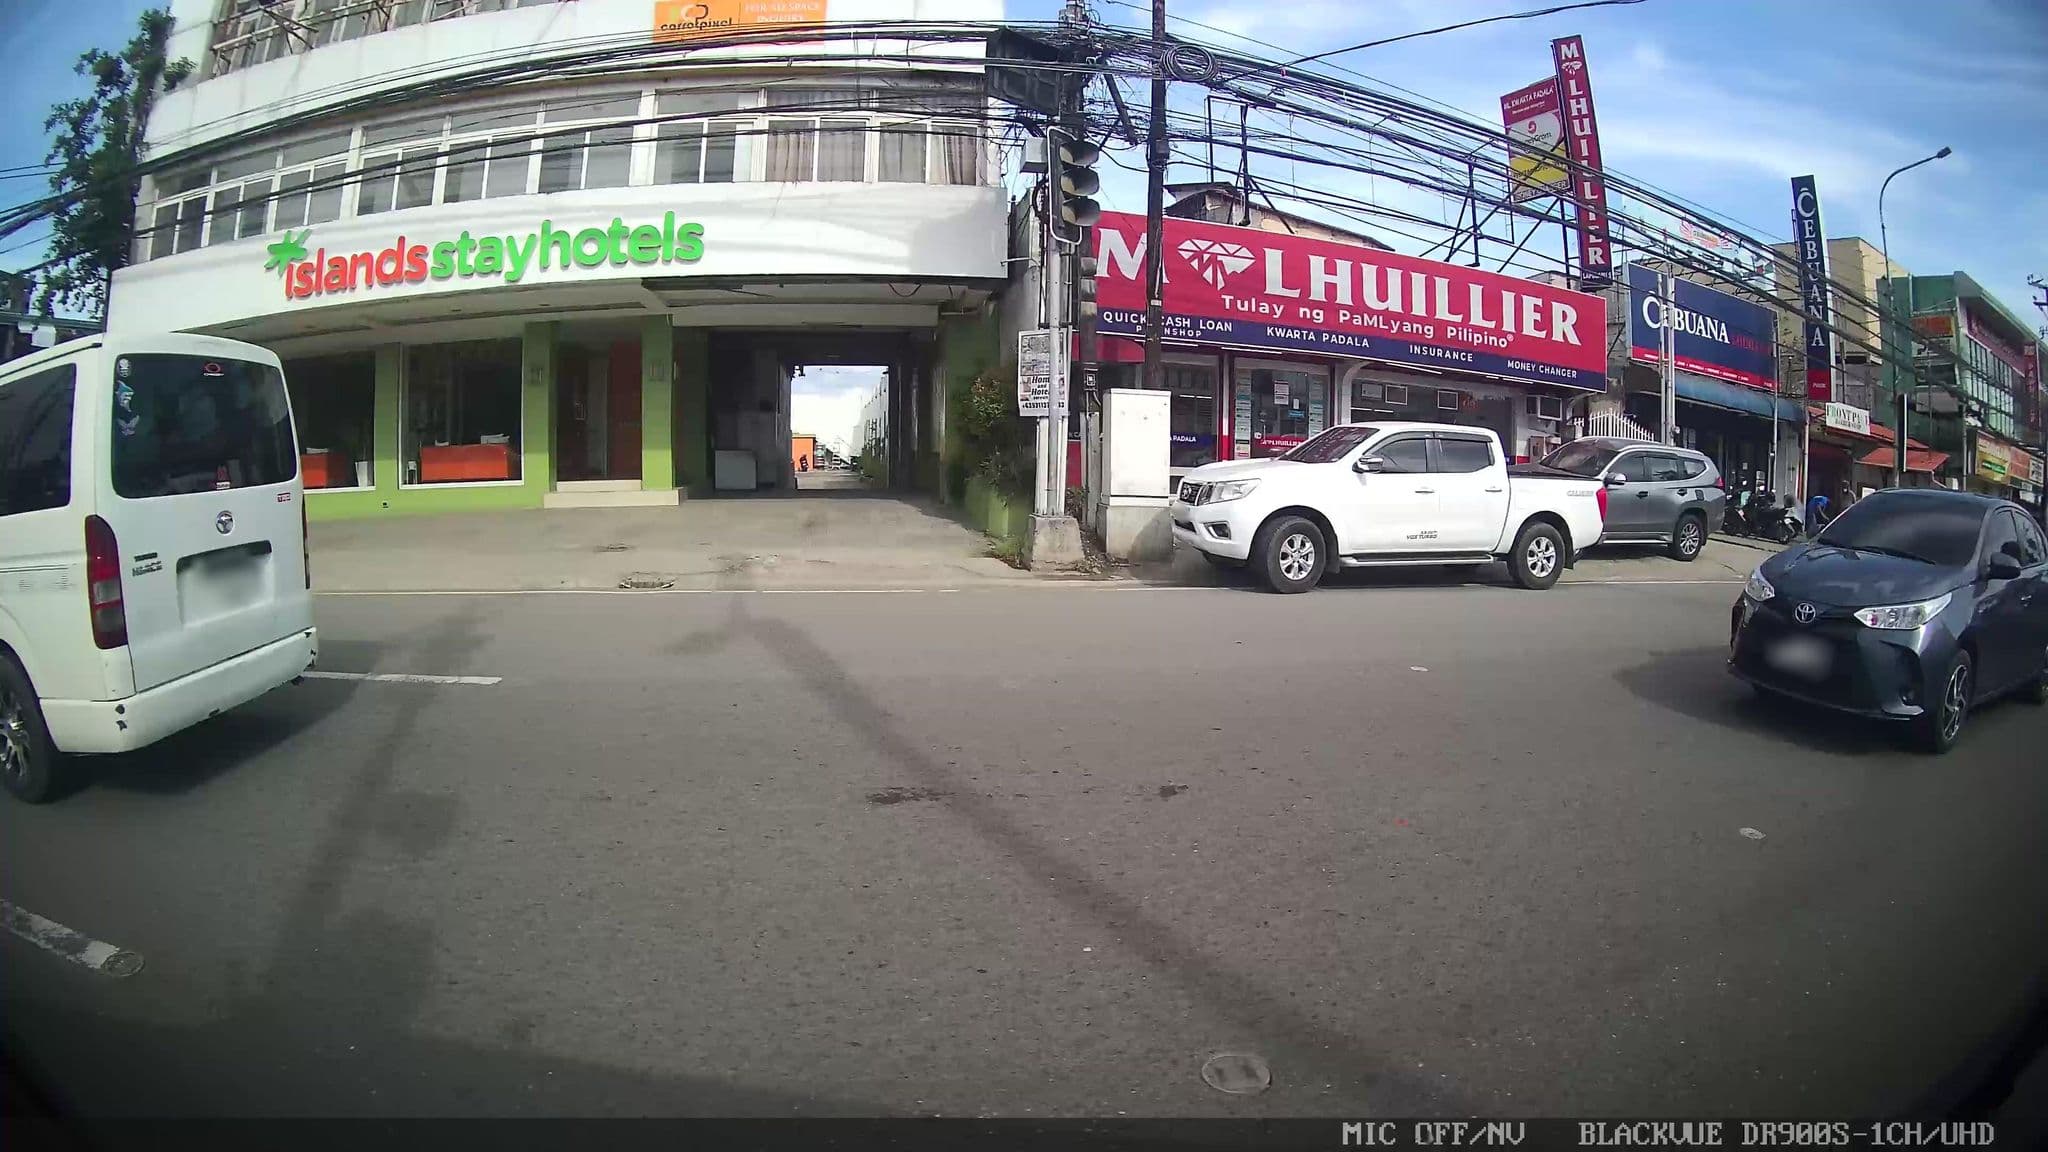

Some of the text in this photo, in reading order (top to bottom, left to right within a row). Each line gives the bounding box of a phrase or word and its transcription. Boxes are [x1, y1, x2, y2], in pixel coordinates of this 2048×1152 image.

[1094, 228, 1582, 346] M LHUILLIER
[1103, 311, 1233, 332] QUICK ASH LOAN
[1222, 295, 1284, 319] Tulay
[1299, 306, 1325, 324] ng
[1339, 311, 1434, 339] PaMLyang
[1136, 325, 1201, 337] PNSHOP
[1267, 326, 1370, 348] KWARTA PADALA
[1409, 345, 1474, 362] INSURANCE
[1507, 360, 1577, 378] MONEY CHANGER
[1031, 376, 1050, 384] Hom
[1031, 388, 1050, 396] Hote
